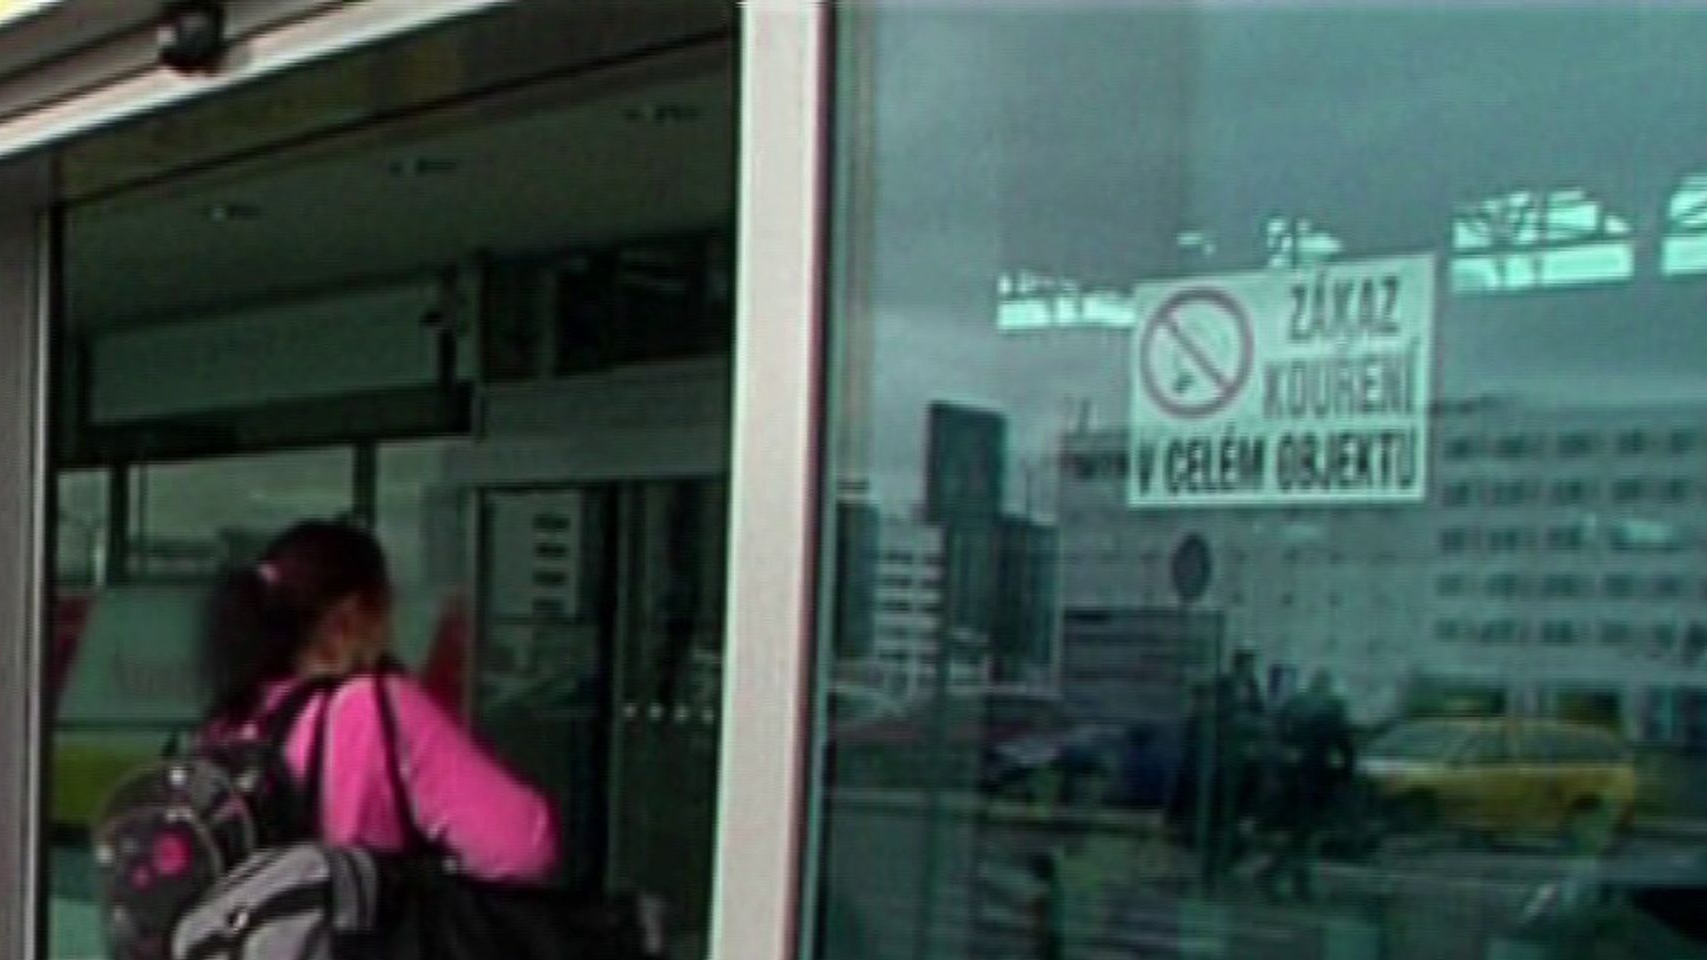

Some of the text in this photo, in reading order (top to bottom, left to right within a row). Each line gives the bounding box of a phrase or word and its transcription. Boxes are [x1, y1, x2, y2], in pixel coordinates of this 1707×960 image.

[1287, 271, 1400, 343] ZÁKAZ
[1137, 422, 1414, 495] V CELÉM OBJEKTU
